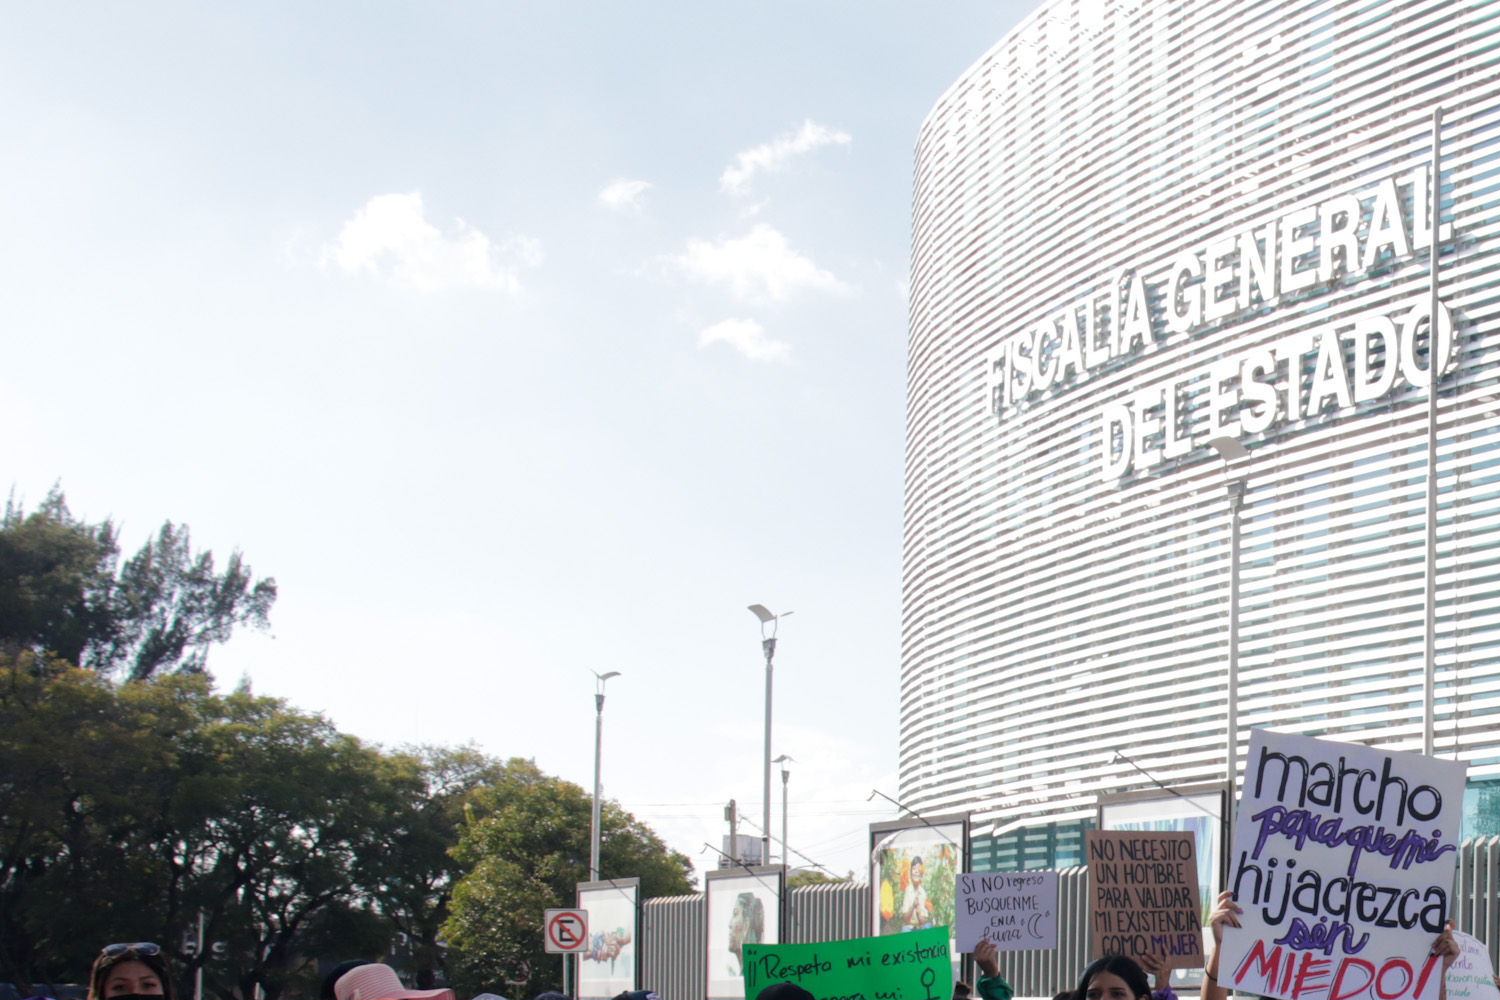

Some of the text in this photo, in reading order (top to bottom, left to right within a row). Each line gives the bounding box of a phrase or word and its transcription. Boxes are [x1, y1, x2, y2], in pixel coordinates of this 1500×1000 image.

[985, 165, 1454, 415] FISCALÍA GENERAL
[1101, 299, 1455, 483] DEL ESTADO
[1255, 746, 1443, 826] marcho
[1090, 839, 1192, 861] NO NECESITO
[1252, 806, 1457, 877] para que mi
[962, 875, 1044, 895] SI NO regreso
[1095, 863, 1185, 885] UN HOMBRE
[1097, 887, 1193, 909] PARA VALIDAR
[1232, 851, 1447, 934] hija crezca
[965, 895, 1039, 915] BUSQUENME
[1094, 910, 1201, 932] MI EXISTENCIA
[979, 926, 1022, 942] luna
[1102, 933, 1199, 956] COMO MUJER
[1273, 916, 1371, 956] sin
[846, 951, 871, 968] mi
[881, 942, 947, 966] existencia
[875, 987, 903, 1000] mi
